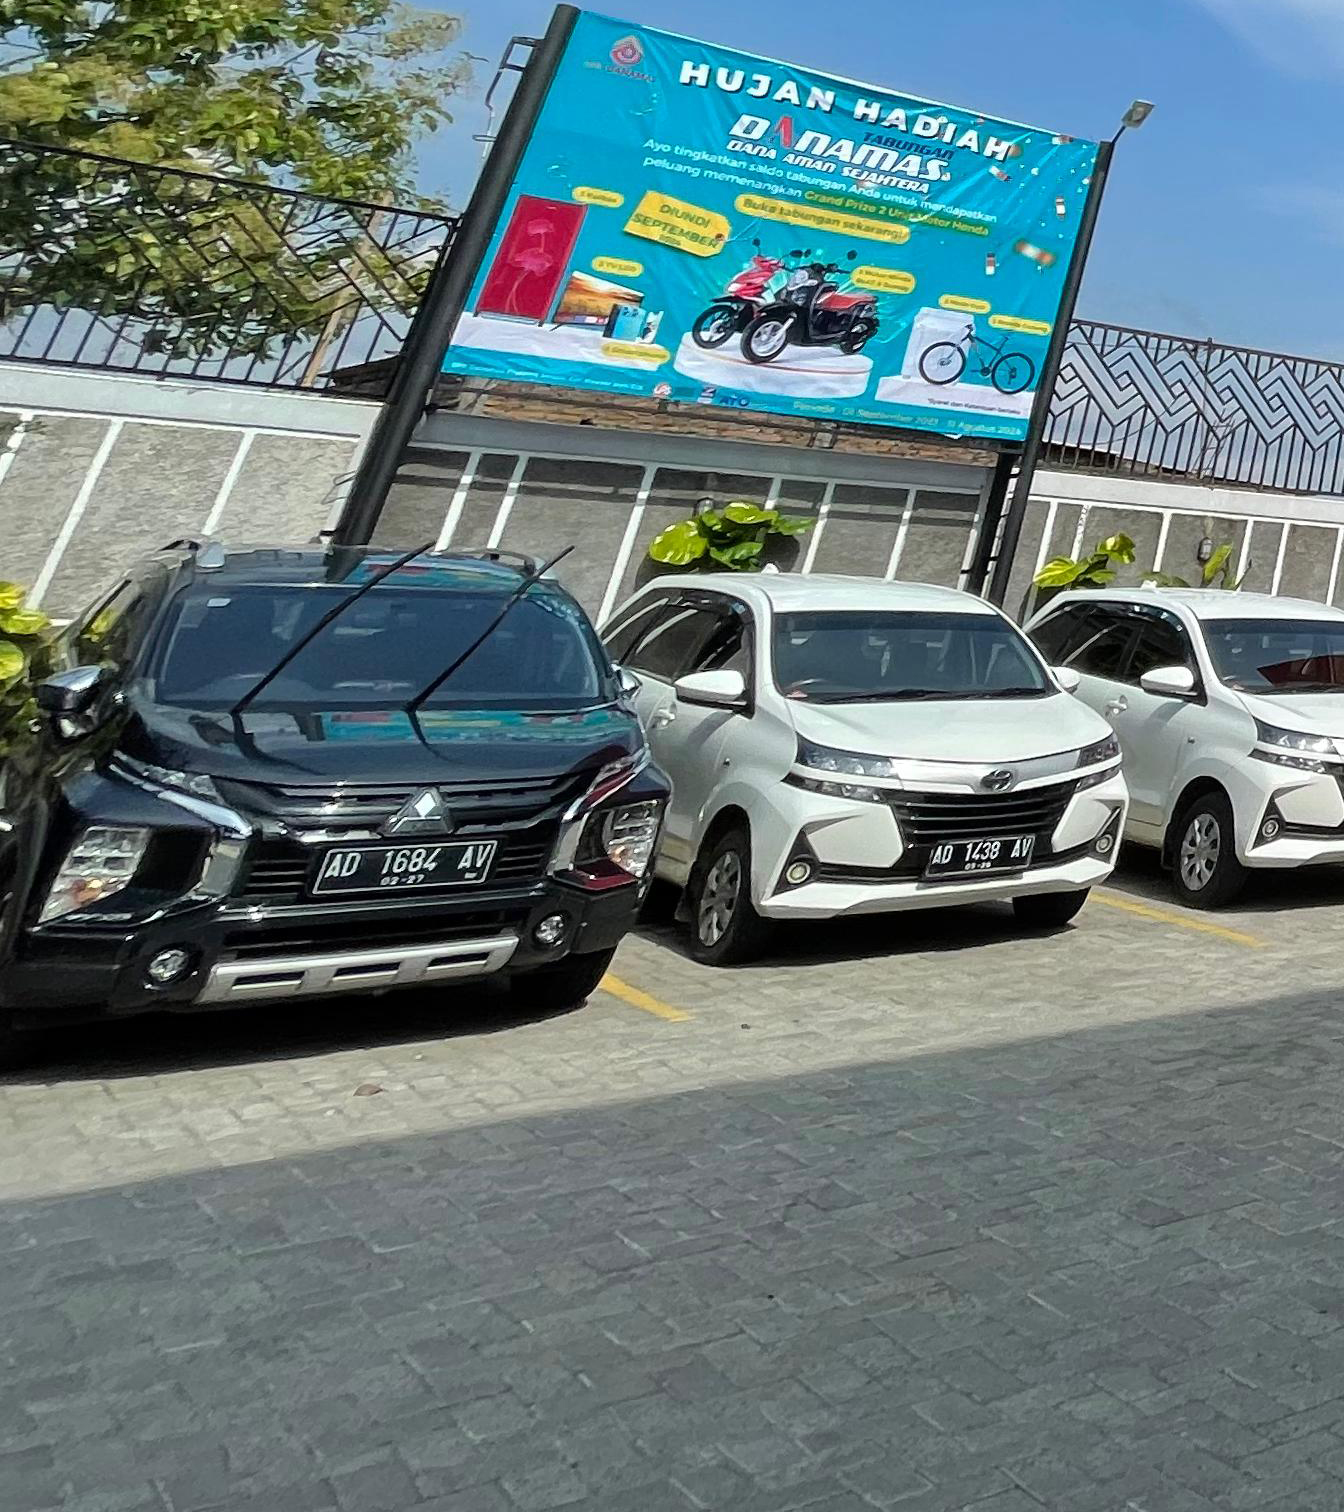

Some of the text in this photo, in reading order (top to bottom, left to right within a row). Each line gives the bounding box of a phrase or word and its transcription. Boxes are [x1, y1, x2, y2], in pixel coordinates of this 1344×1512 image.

[679, 59, 1013, 162] HUJAN HADIAH
[864, 131, 956, 161] TABUNGAN
[643, 139, 998, 225] Ayo tingkatkan saldo tabungan Anda untuk mendapatkan
[726, 139, 931, 194] DANA AMAN SEJAHTERA
[643, 156, 701, 178] peluang
[703, 169, 802, 199] memenangkan
[804, 189, 844, 207] Grand
[846, 197, 877, 215] Prize
[878, 205, 888, 216] 2
[632, 212, 719, 249] SEPTEMBER
[659, 204, 711, 229] DIUNDI
[742, 198, 776, 214] Buka
[779, 205, 840, 228] tabungan
[324, 844, 492, 879] AD 1684 AV
[932, 838, 1032, 865] AD 1438 AV
